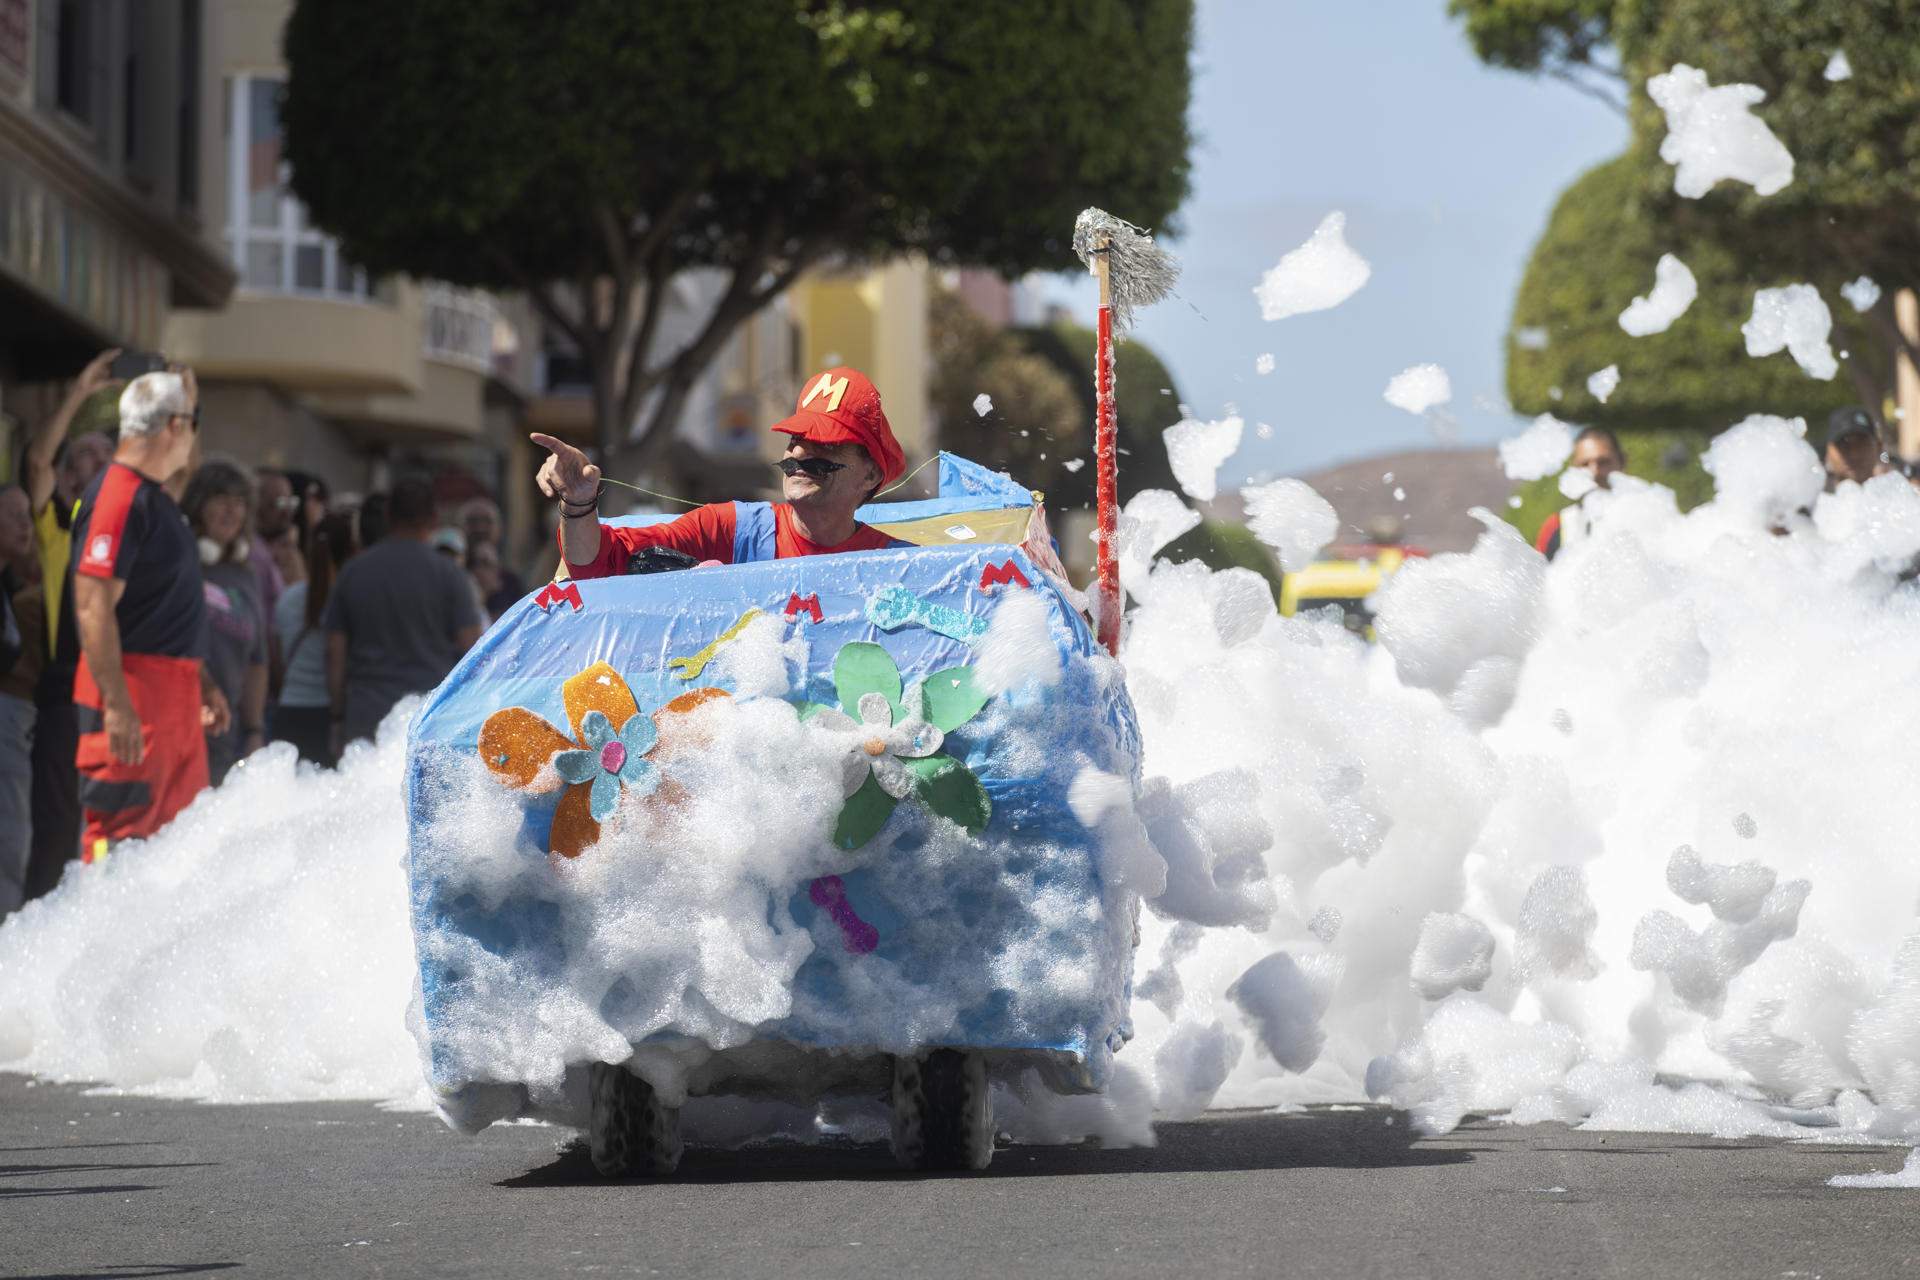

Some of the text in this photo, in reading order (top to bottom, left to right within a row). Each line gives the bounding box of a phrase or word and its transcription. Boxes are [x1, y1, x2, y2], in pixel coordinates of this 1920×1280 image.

[802, 373, 849, 412] M
[979, 557, 1032, 594] M
[534, 581, 584, 613] M
[784, 591, 825, 624] M
